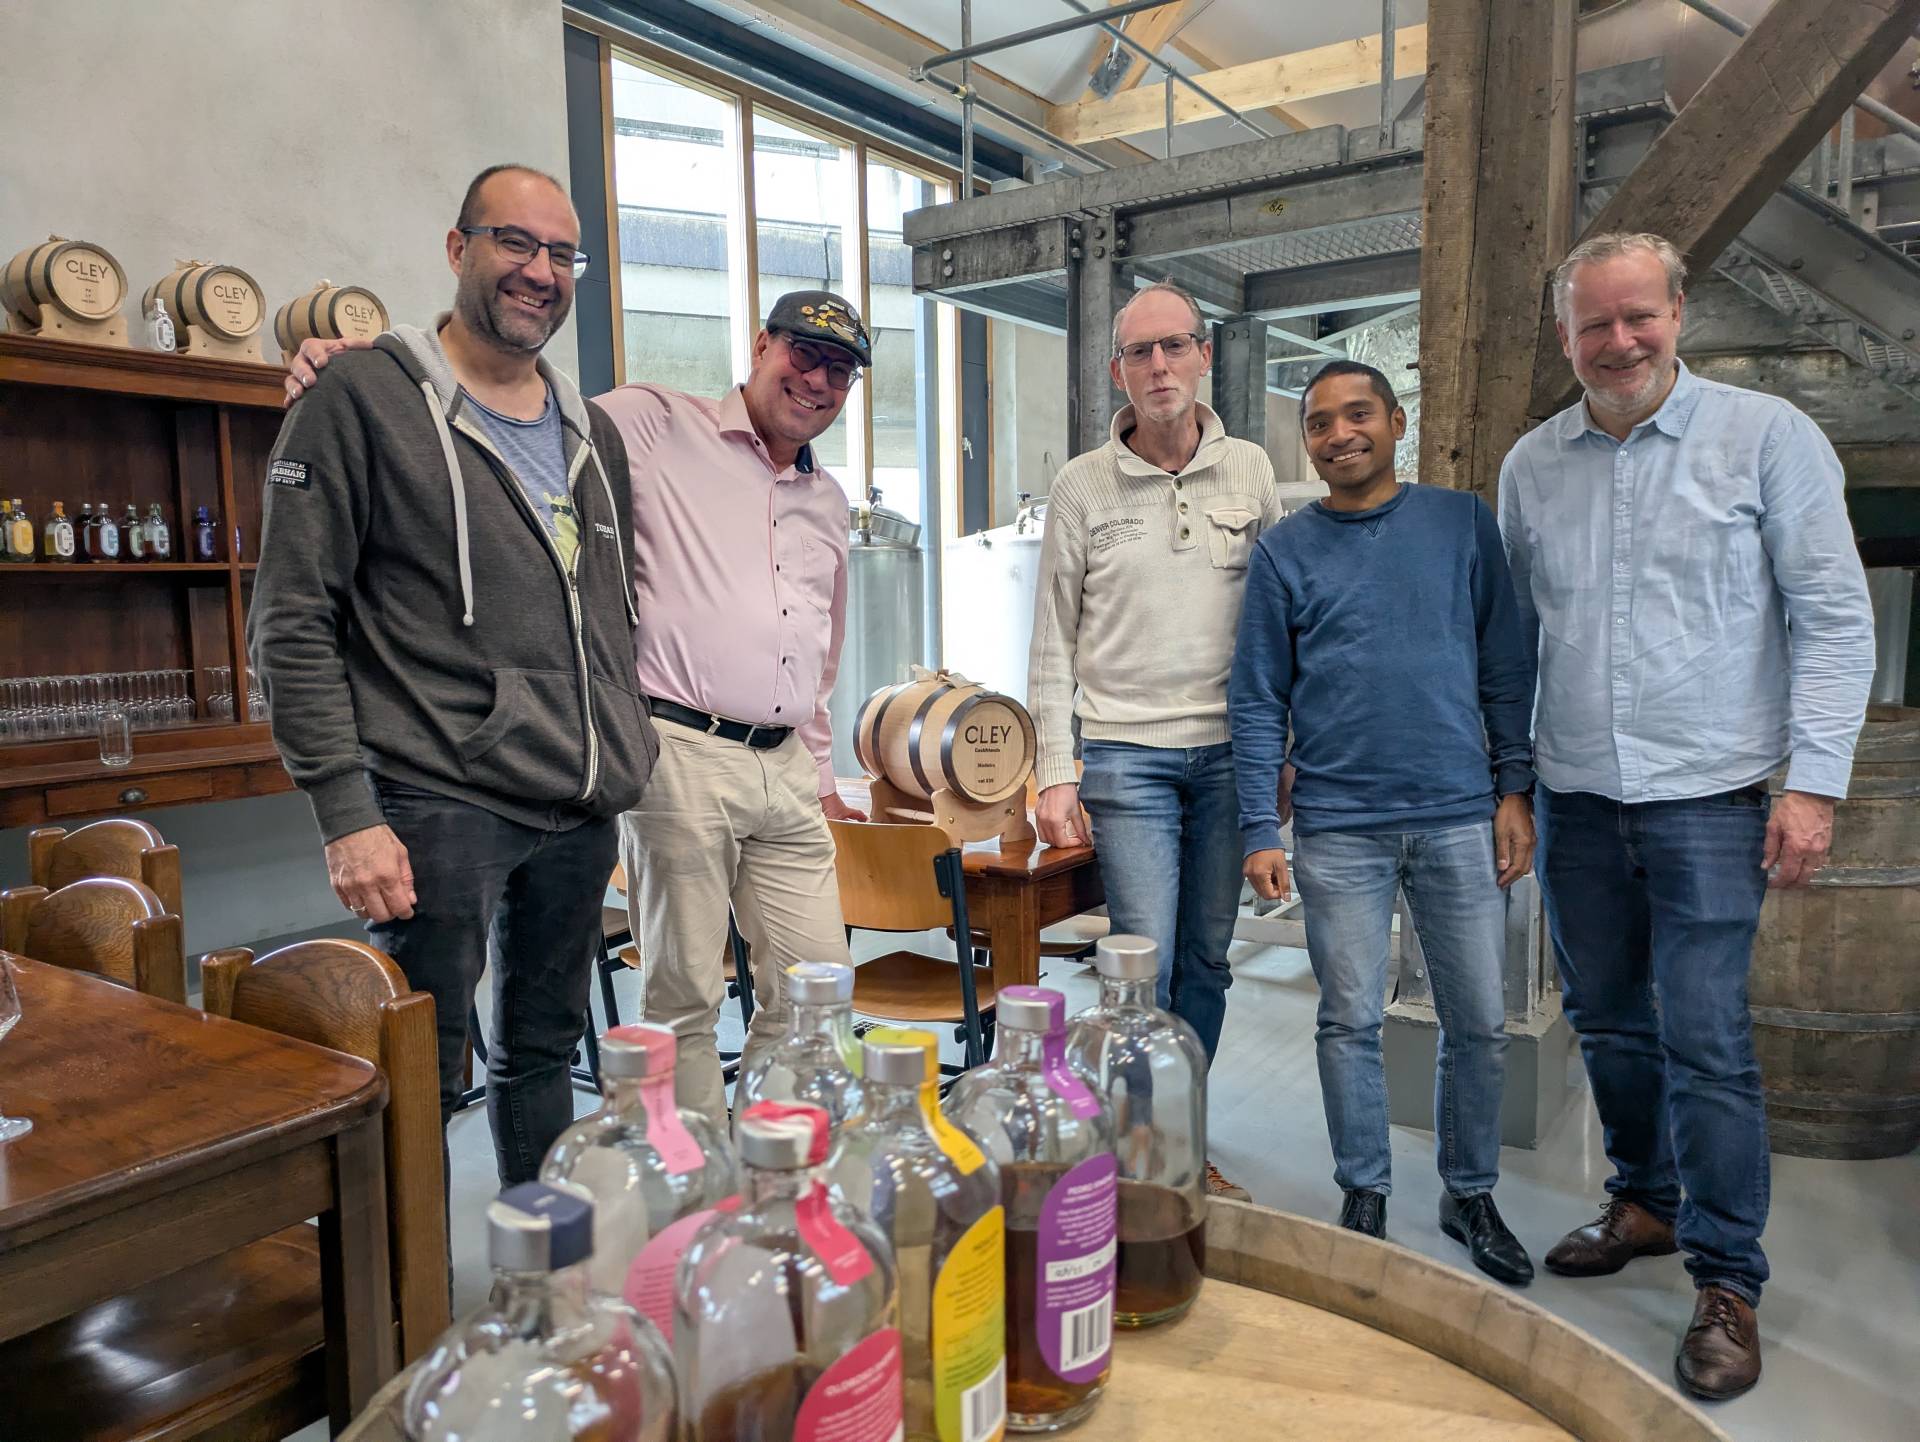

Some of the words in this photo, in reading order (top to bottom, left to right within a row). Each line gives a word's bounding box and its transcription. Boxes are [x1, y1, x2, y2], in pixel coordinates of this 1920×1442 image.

[66, 259, 108, 279] CLEY
[213, 285, 248, 300] CLEY
[344, 304, 374, 319] CLEY
[1110, 519, 1144, 527] COLORADO
[965, 725, 1012, 744] CLEY
